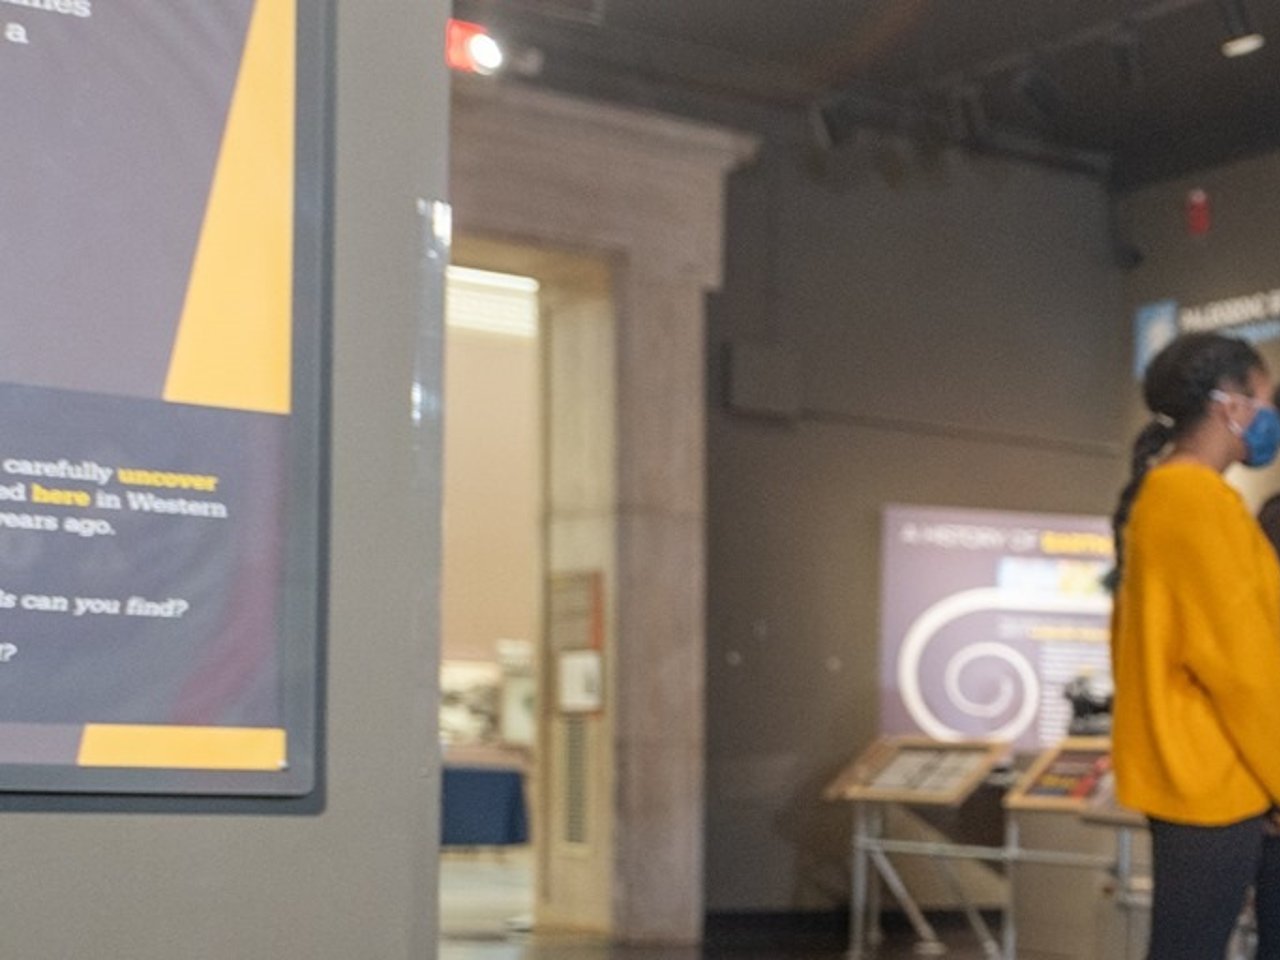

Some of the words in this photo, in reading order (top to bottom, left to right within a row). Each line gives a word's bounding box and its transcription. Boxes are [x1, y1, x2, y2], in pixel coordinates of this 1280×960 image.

[5, 22, 29, 44] a
[3, 458, 114, 485] carefully
[117, 467, 220, 492] uncover
[31, 482, 91, 508] here
[95, 489, 122, 510] in
[126, 490, 229, 518] Western
[0, 512, 59, 531] ears
[63, 516, 117, 537] ago.
[0, 589, 17, 609] s
[21, 594, 69, 612] can
[73, 596, 121, 616] you
[126, 595, 190, 618] find?
